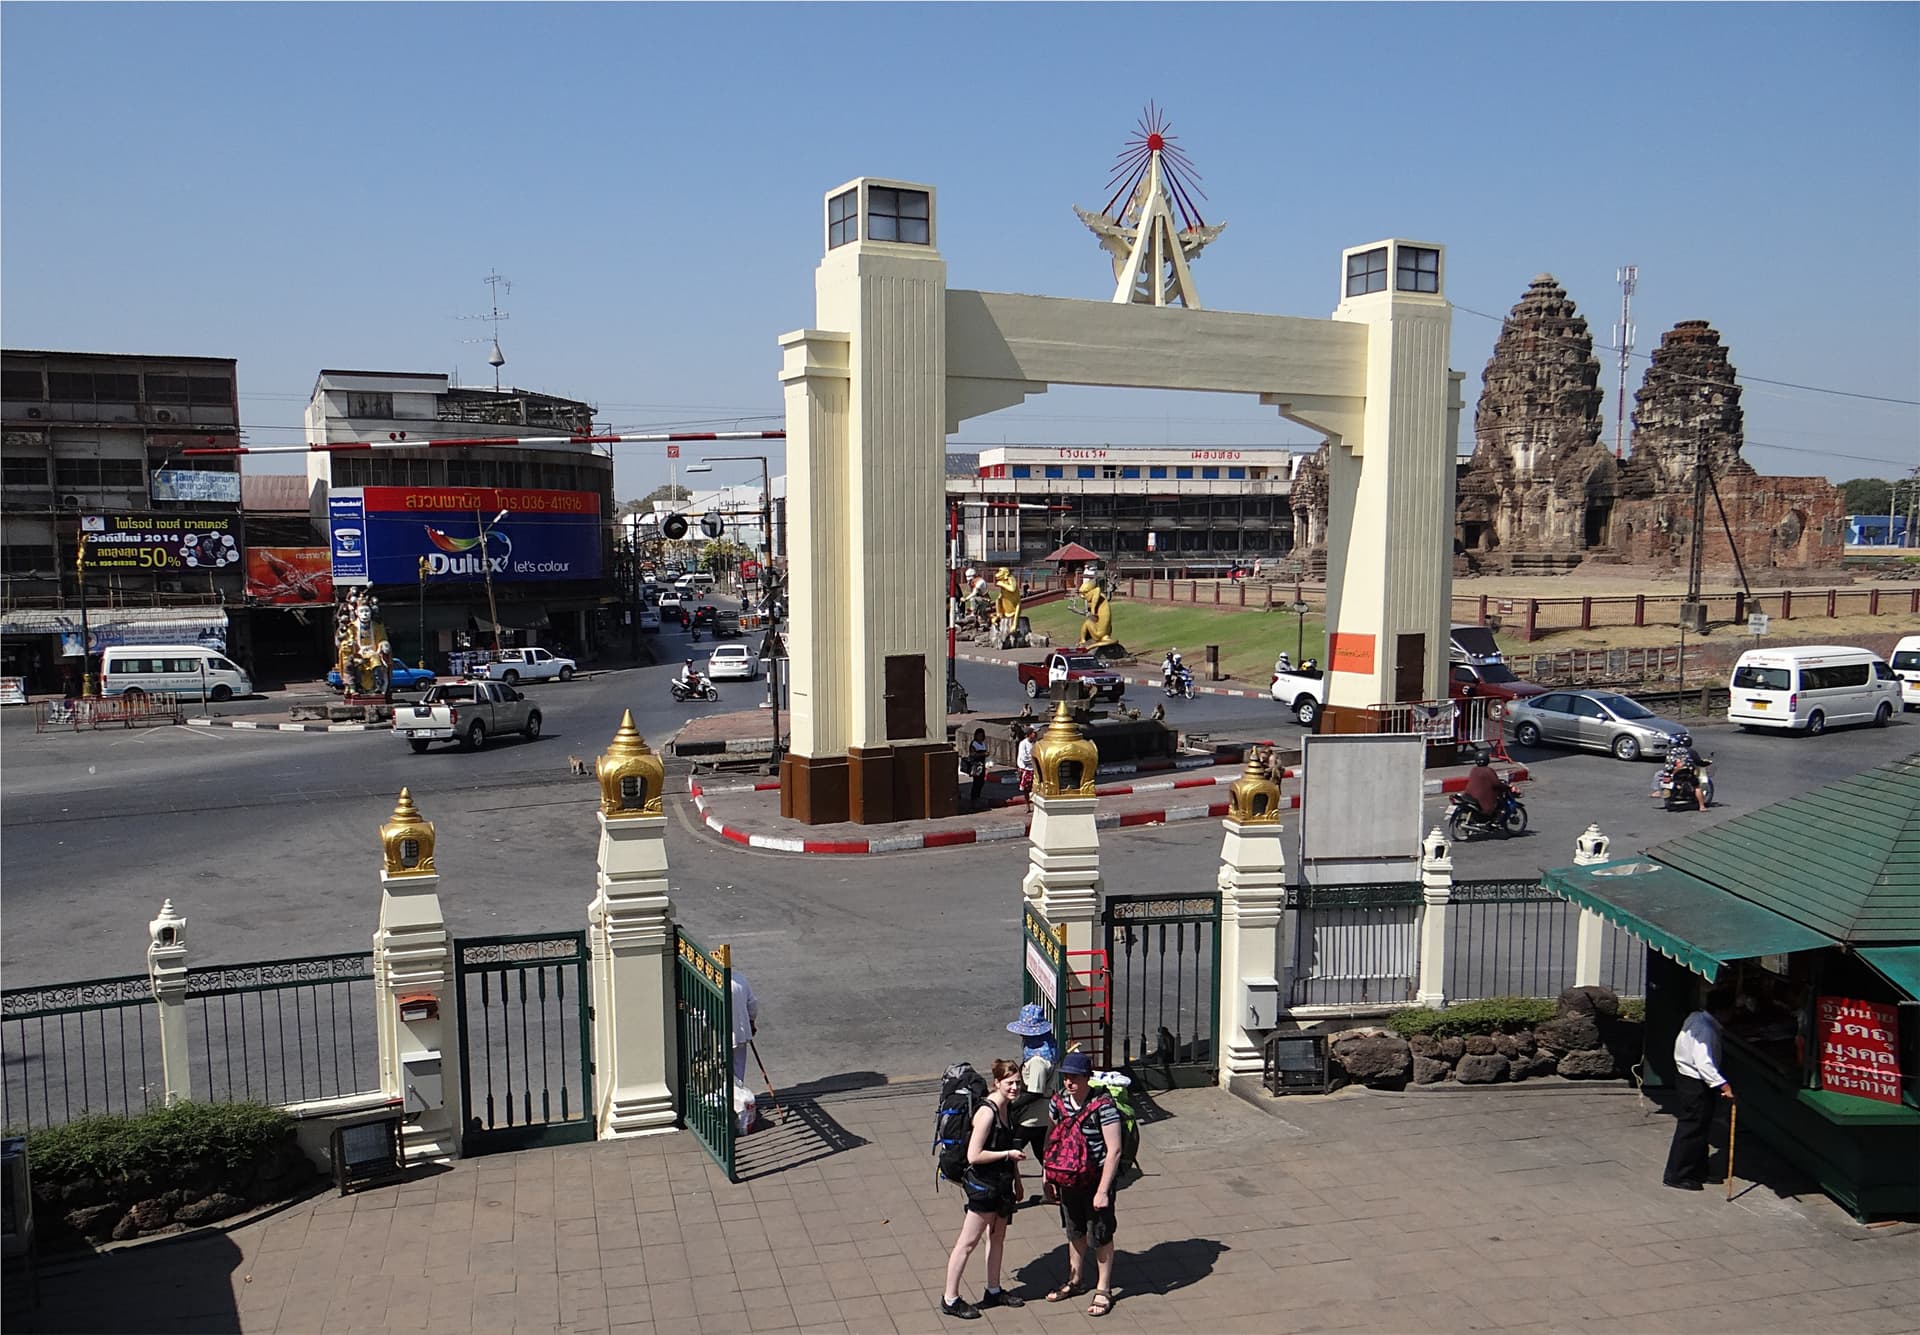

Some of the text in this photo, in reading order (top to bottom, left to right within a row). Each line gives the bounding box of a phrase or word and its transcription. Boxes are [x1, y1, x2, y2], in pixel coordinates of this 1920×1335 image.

[1059, 448, 1107, 458] โรงแรม
[406, 492, 482, 509] สงวนพานิช
[114, 517, 153, 529] ไพโรจน์
[184, 518, 229, 529] มาสเตอร์
[144, 534, 179, 542] 2014
[139, 547, 181, 567] 50%
[429, 553, 569, 575] Dulux let's colour
[1823, 1001, 1894, 1023] จำหน่าย
[1823, 1014, 1894, 1050] วัตถุ
[1824, 1042, 1895, 1065] มงคล
